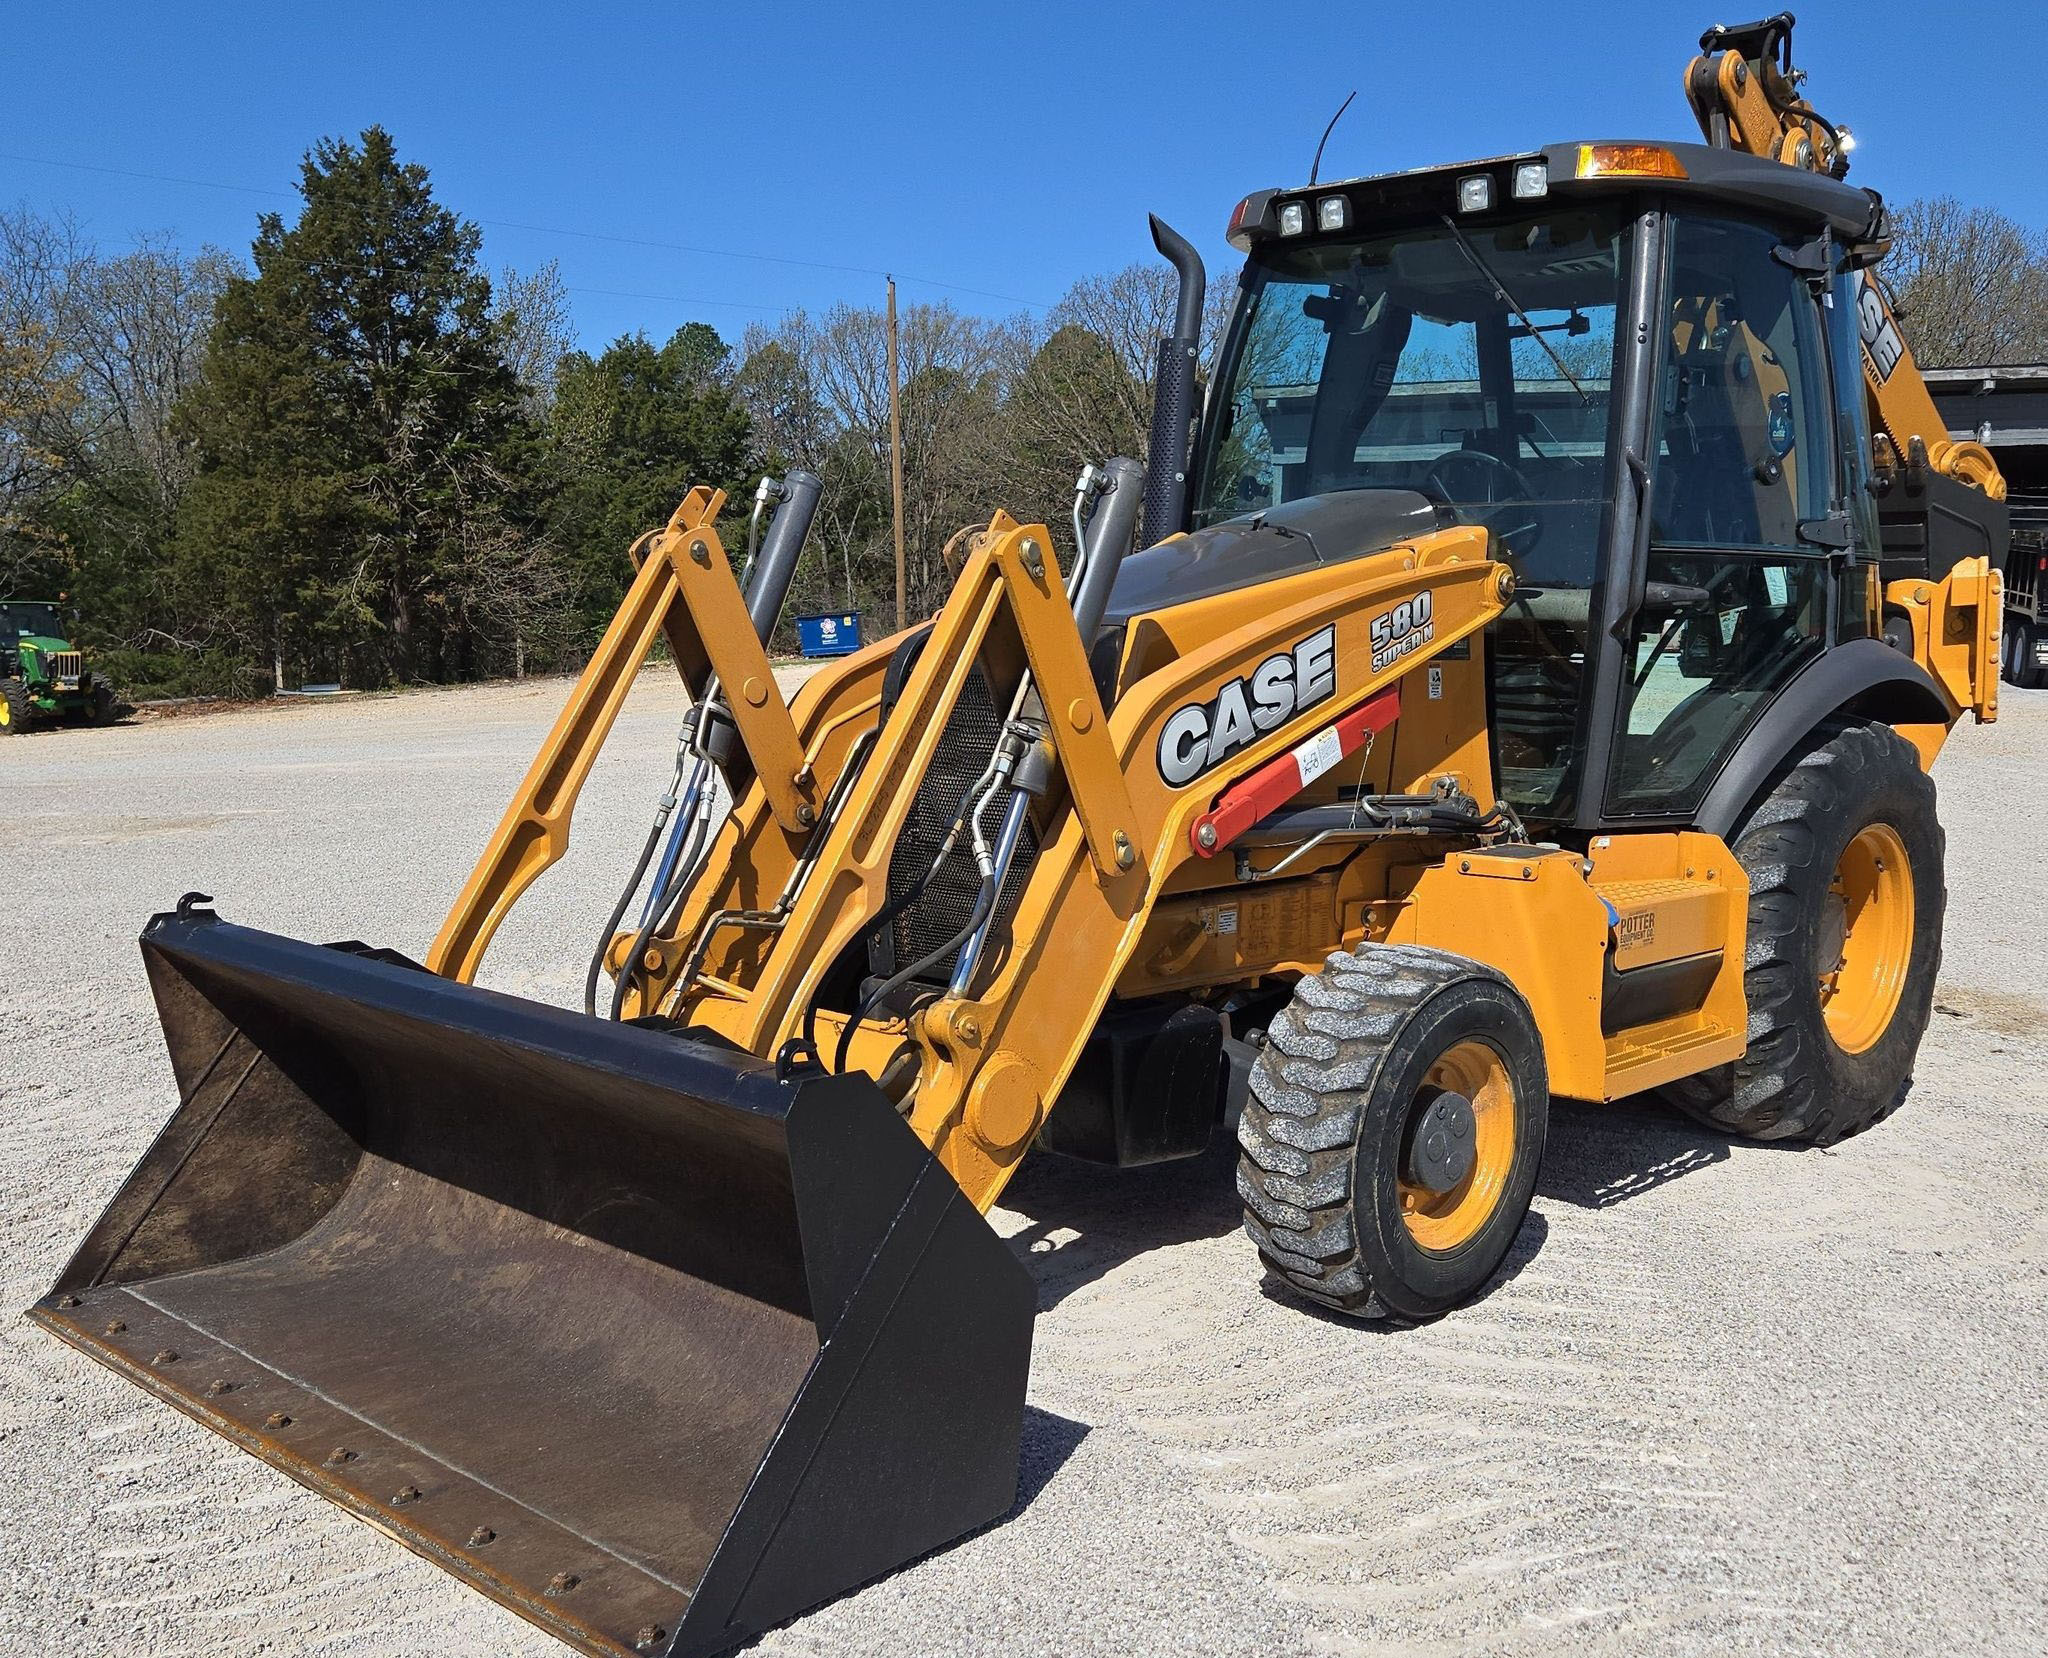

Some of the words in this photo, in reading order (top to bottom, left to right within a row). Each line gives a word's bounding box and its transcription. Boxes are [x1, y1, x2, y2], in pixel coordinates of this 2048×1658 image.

[1854, 269, 1904, 382] SE
[1370, 590, 1432, 654] 580
[1372, 630, 1422, 673] SUPER
[1423, 622, 1434, 643] N
[1157, 623, 1336, 787] CASE
[1620, 912, 1655, 935] POTTER
[1620, 929, 1646, 944] EQUIPMENT
